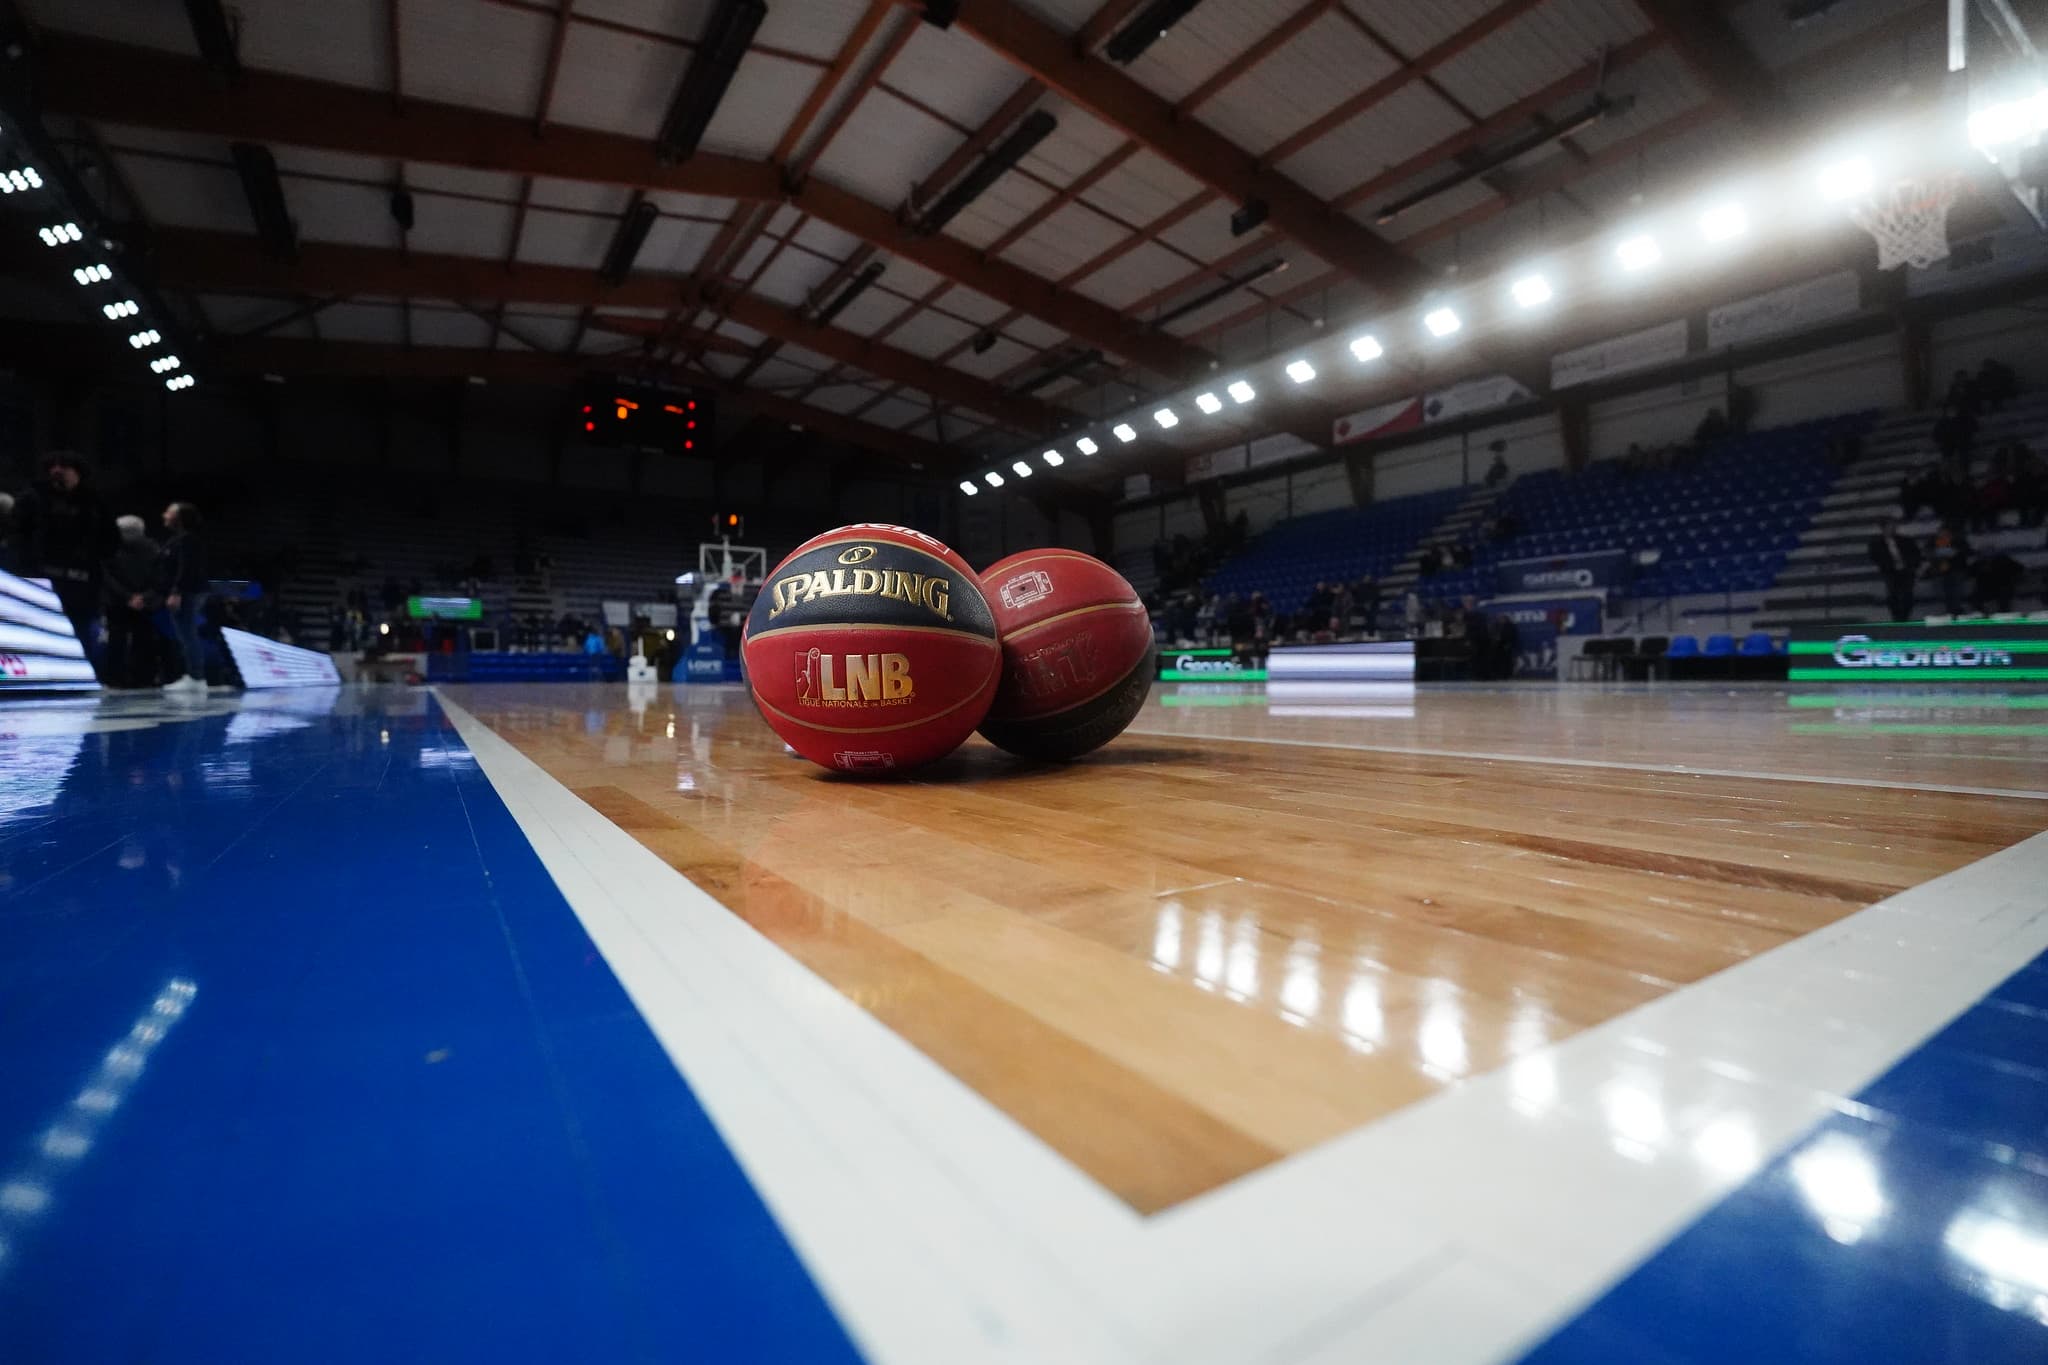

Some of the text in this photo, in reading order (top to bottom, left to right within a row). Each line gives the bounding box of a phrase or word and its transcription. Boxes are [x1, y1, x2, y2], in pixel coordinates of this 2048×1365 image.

[768, 568, 950, 620] SPALDING
[820, 654, 912, 700] LNB
[821, 700, 868, 708] NATIONALE
[881, 698, 912, 707] BASKET
